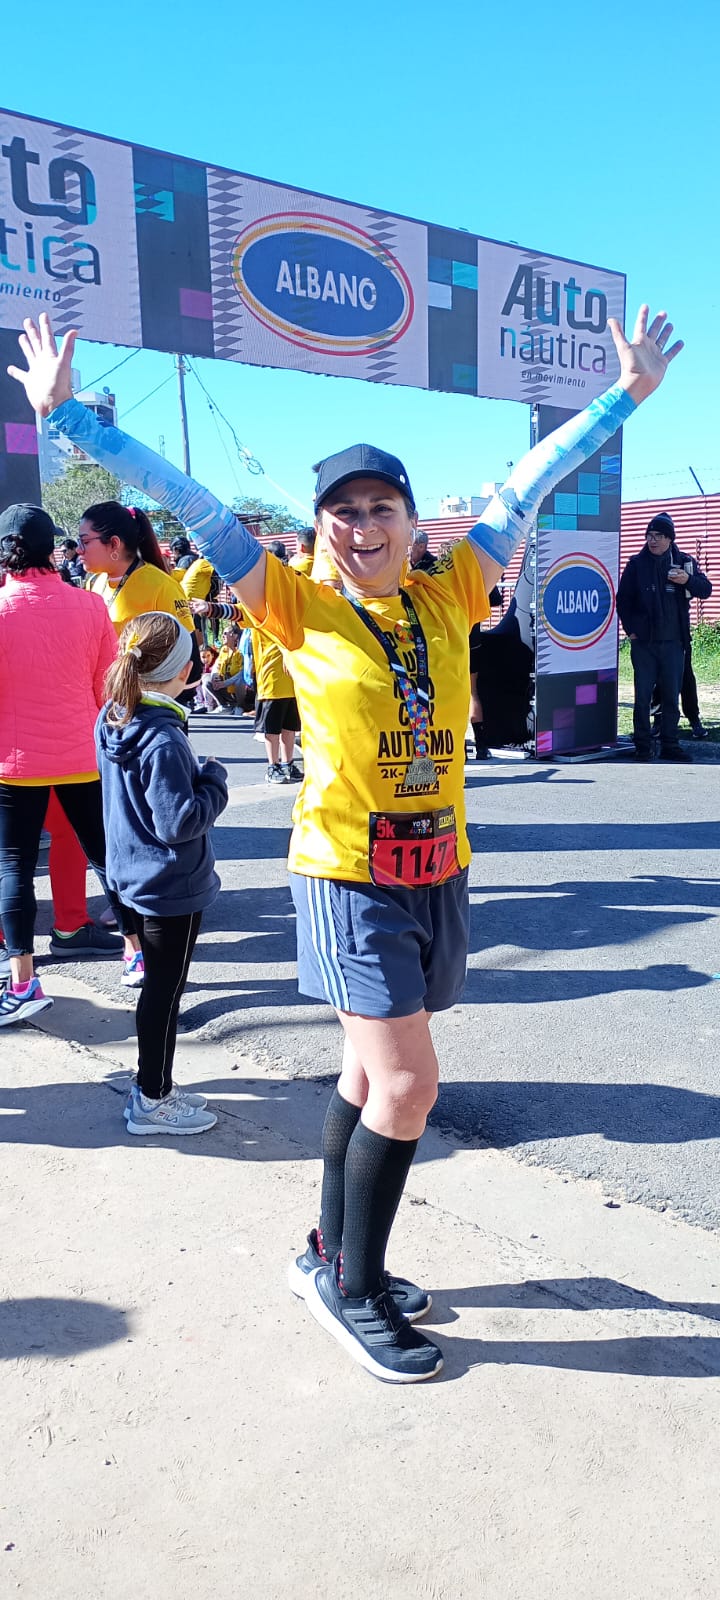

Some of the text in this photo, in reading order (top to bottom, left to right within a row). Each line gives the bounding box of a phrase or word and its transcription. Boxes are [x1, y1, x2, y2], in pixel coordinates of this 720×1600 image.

[275, 259, 377, 311] ALBANO
[501, 264, 607, 334] Auto
[500, 325, 606, 374] náutica
[521, 370, 586, 388] en movimiento
[556, 589, 599, 614] ALBANO
[377, 729, 454, 759] AUTMO
[376, 819, 396, 838] 5k
[391, 841, 448, 879] 1147
[156, 1111, 178, 1123] FILA
